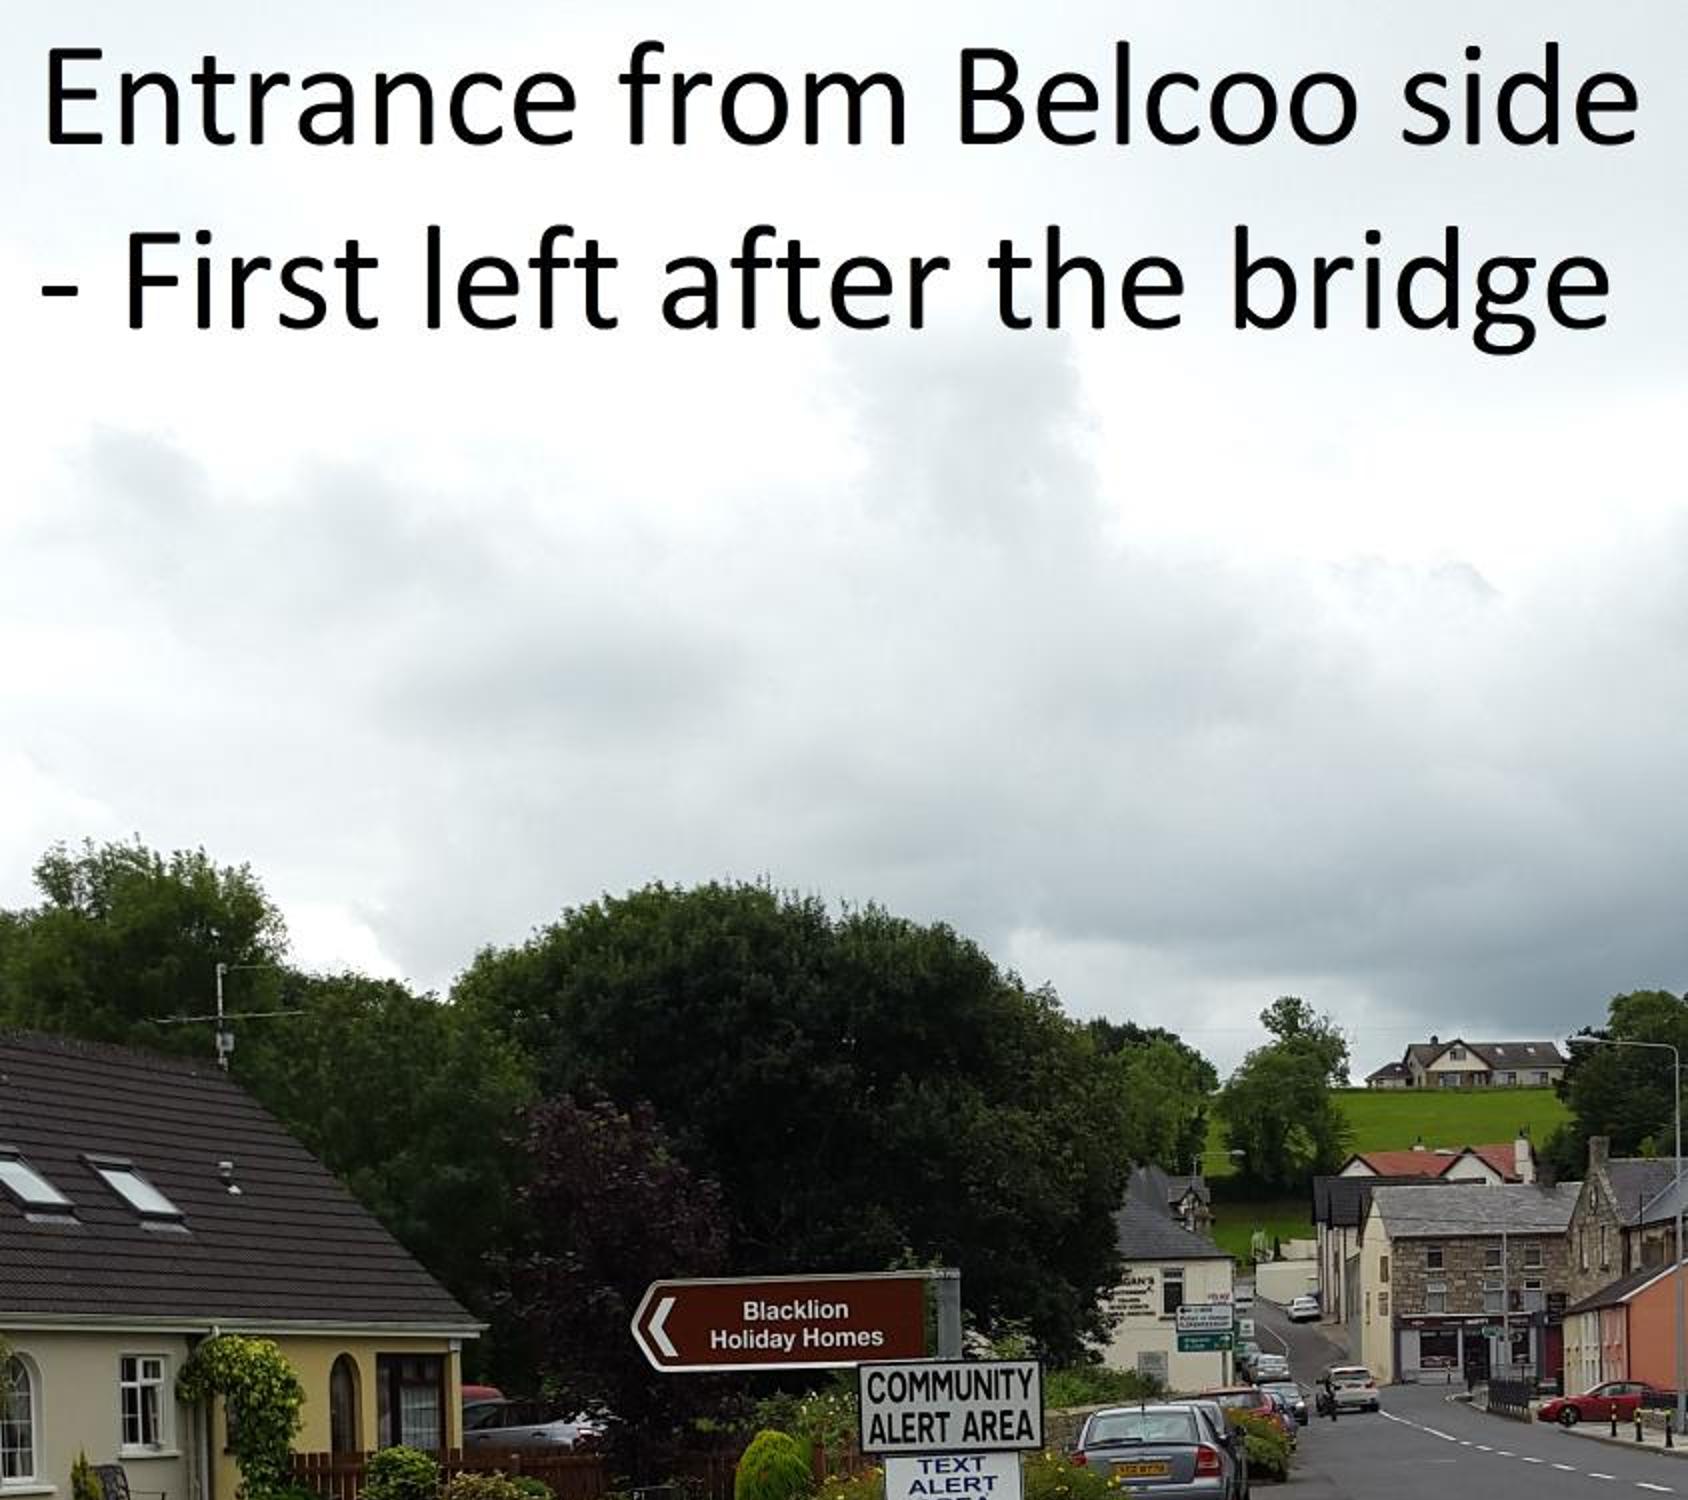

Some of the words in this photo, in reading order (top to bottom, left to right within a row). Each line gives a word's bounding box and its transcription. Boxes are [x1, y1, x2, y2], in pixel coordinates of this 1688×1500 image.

[743, 1299, 849, 1321] Blacklion
[710, 1328, 796, 1352] Holiday
[802, 1327, 884, 1347] Homes
[867, 1367, 1034, 1404] COMMUNITY
[869, 1411, 951, 1444] ALERT
[962, 1409, 1034, 1442] AREA
[917, 1456, 987, 1475] TEXT
[909, 1475, 999, 1495] ALERT
